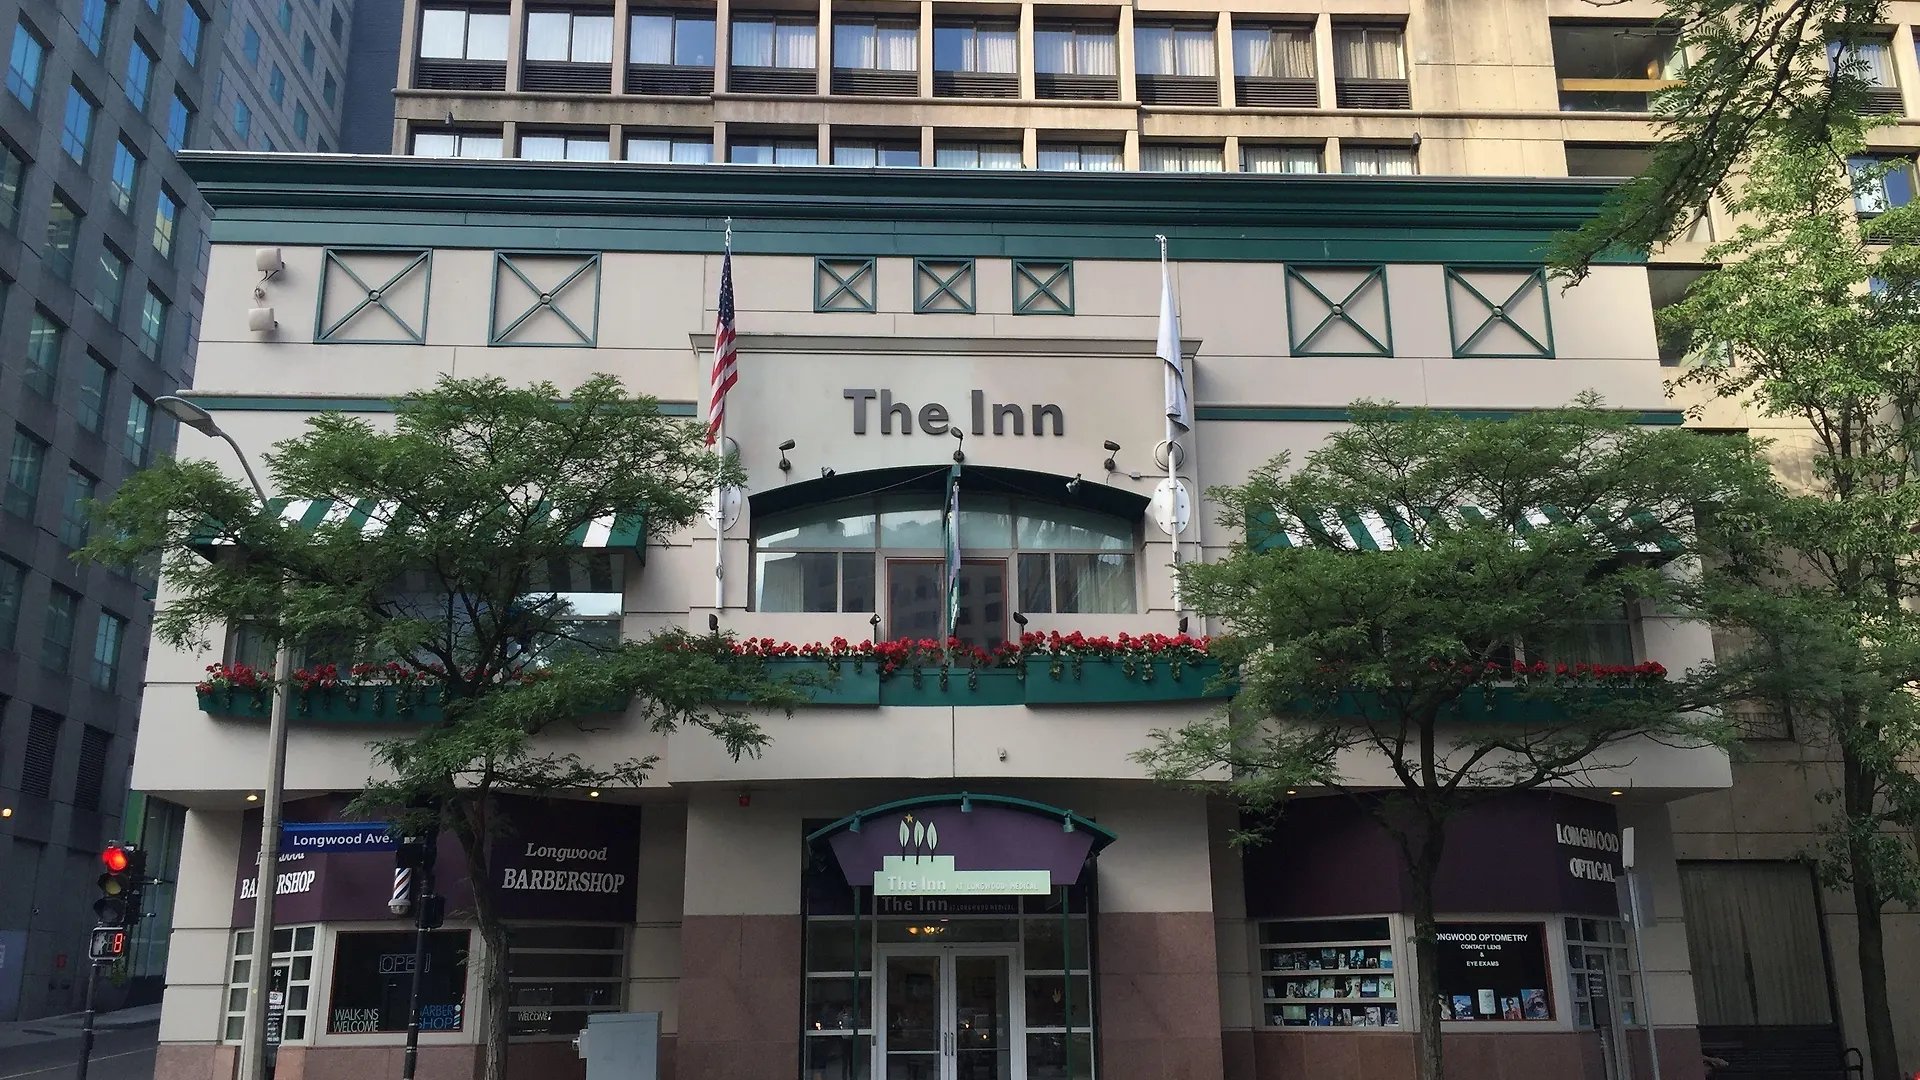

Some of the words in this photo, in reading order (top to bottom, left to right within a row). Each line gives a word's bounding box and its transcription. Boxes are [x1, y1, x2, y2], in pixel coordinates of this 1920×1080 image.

[843, 388, 950, 436] The
[971, 389, 1064, 436] Inn
[293, 833, 362, 847] Longwood
[365, 833, 394, 844] Ave.
[1556, 823, 1619, 853] LONGWOOD
[525, 842, 608, 862] Longwood
[1569, 857, 1616, 883] OPTICAL
[239, 870, 316, 900] BARSHOP
[501, 868, 625, 893] BARBERSHOP
[887, 876, 917, 892] The
[920, 876, 947, 892] Inn
[881, 896, 913, 911] The
[918, 895, 948, 911] Inn
[113, 932, 124, 953] 8
[1478, 933, 1529, 943] OPTOMETRY
[1460, 943, 1486, 951] CONTACT
[1486, 943, 1502, 951] LENS
[1479, 960, 1500, 968] EXAMS
[334, 1008, 380, 1021] WALK-INS
[419, 1004, 454, 1017] ARBER
[333, 1020, 380, 1033] WELCOME
